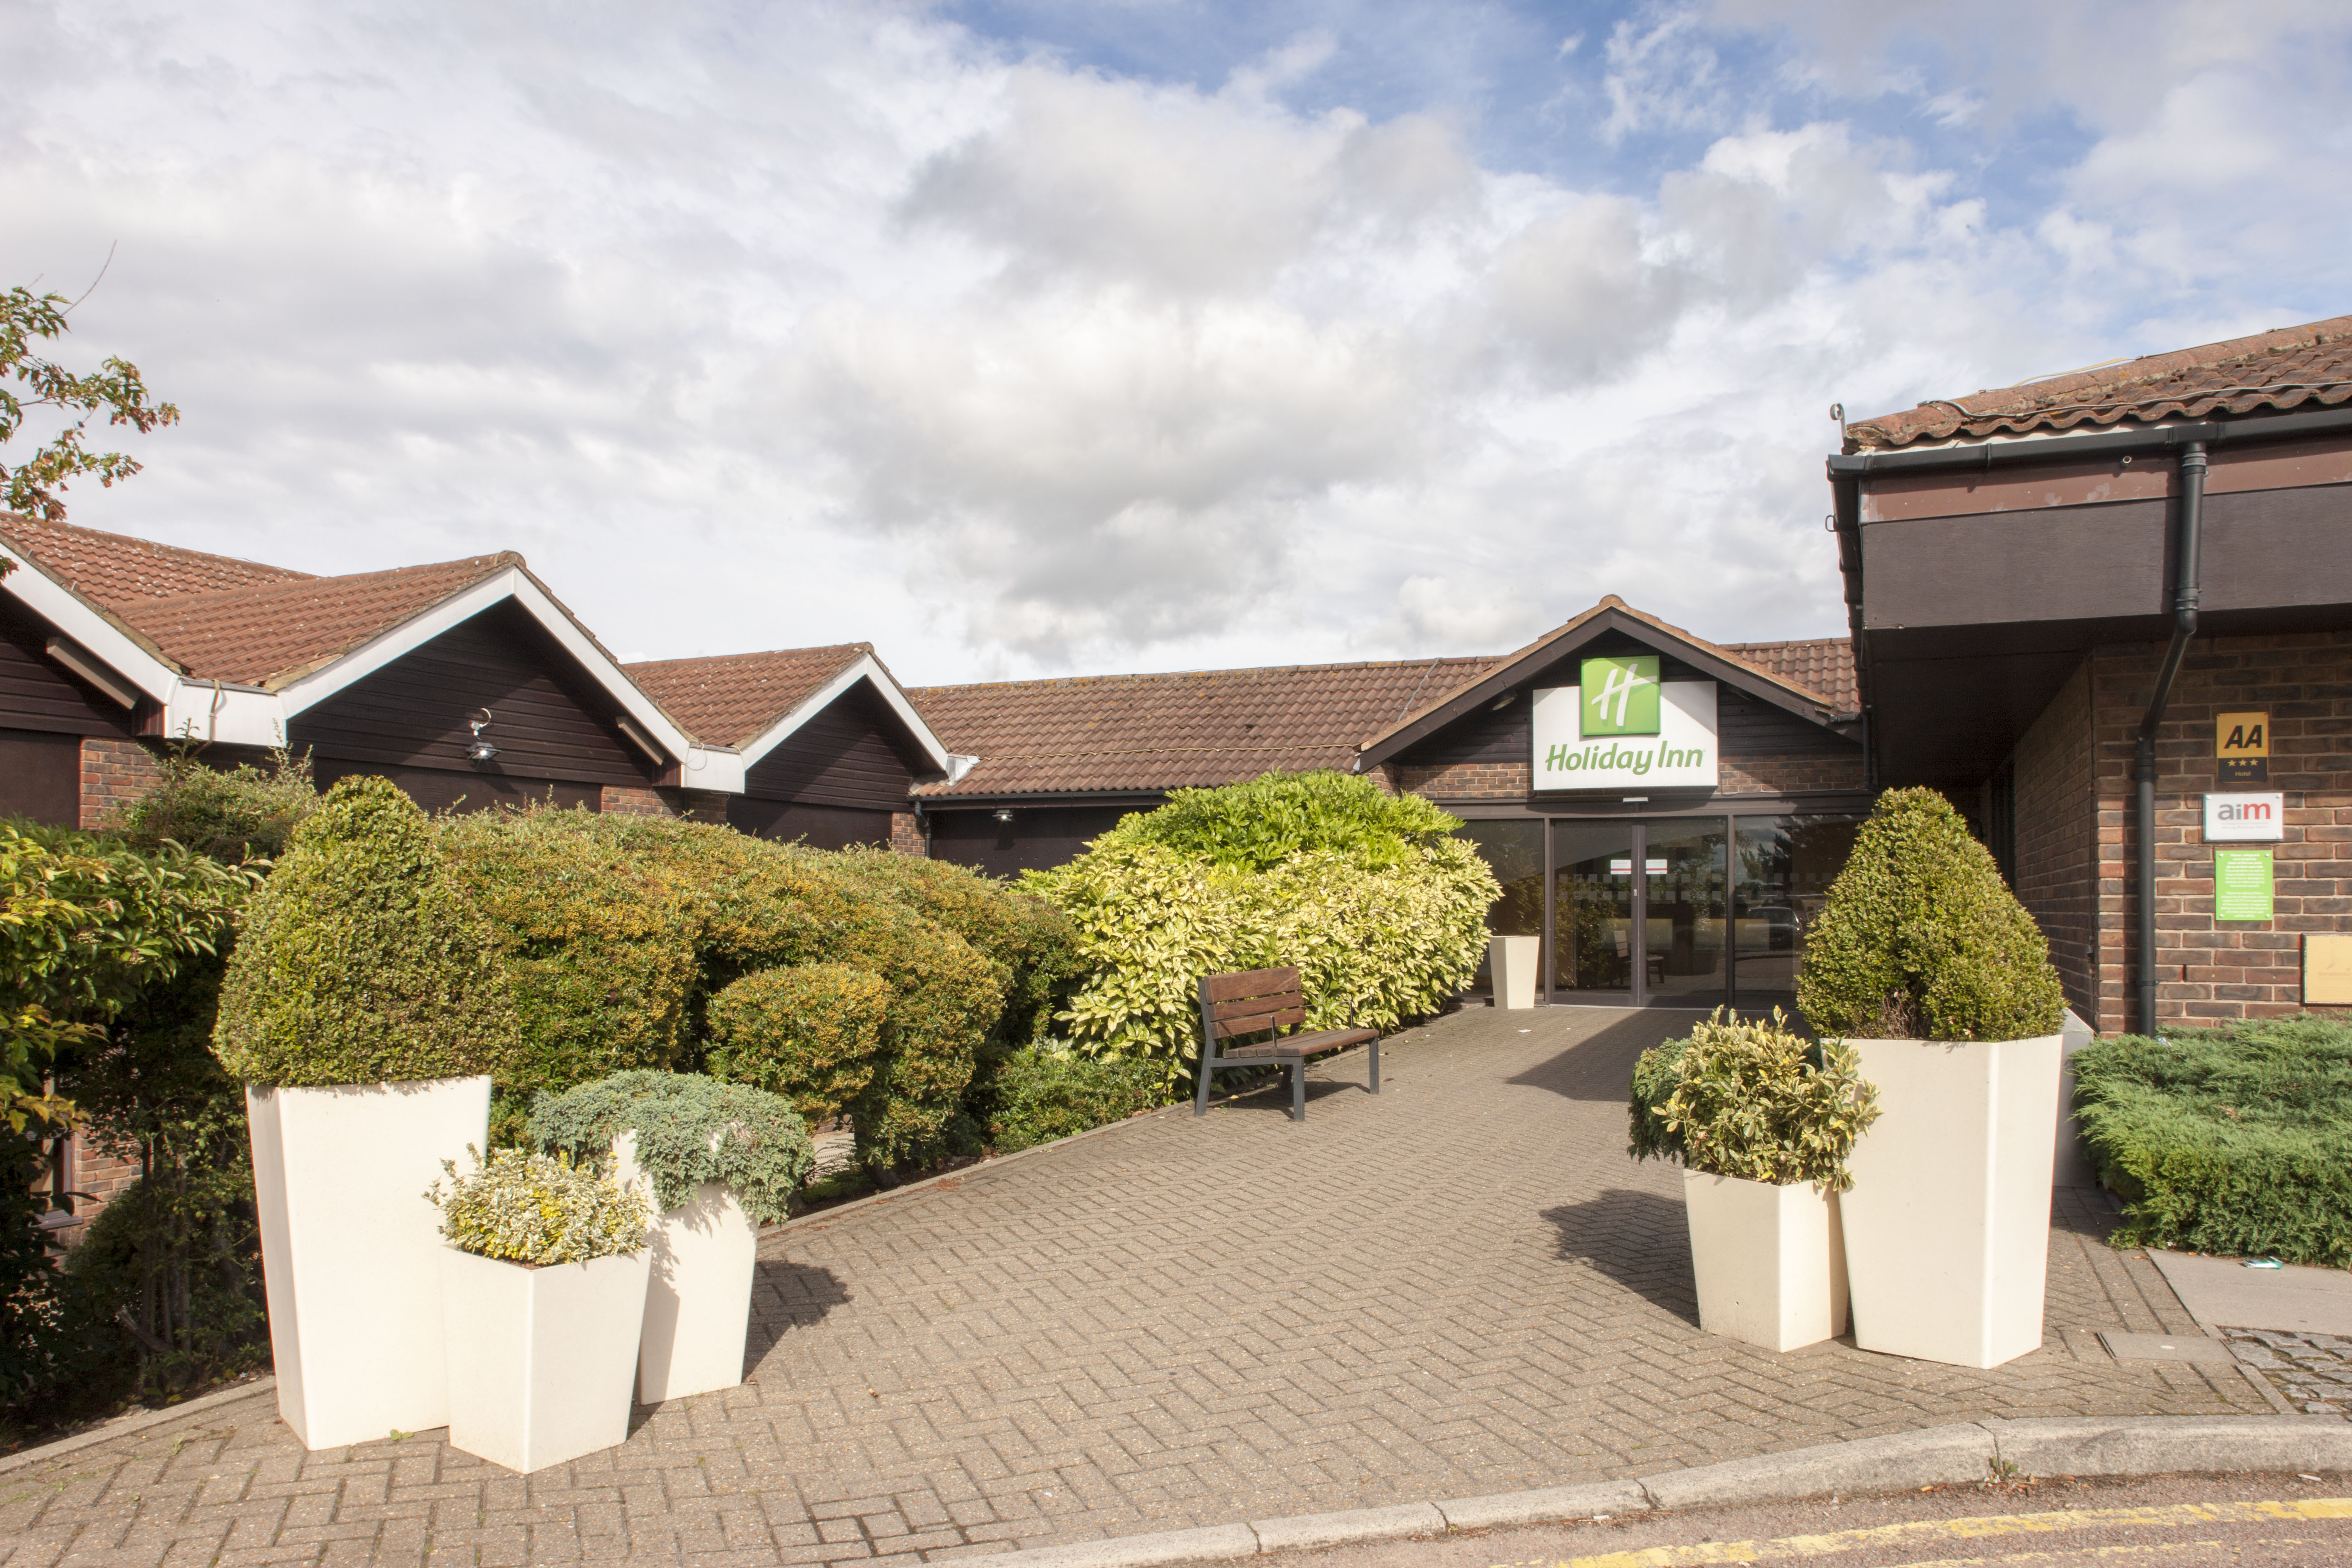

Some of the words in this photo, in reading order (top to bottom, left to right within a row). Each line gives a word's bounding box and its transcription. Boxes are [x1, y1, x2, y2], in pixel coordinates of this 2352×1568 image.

[2224, 725, 2262, 749] AA
[1545, 743, 1653, 775] Holiday
[1658, 741, 1703, 768] Inn
[2218, 803, 2271, 820] aim
